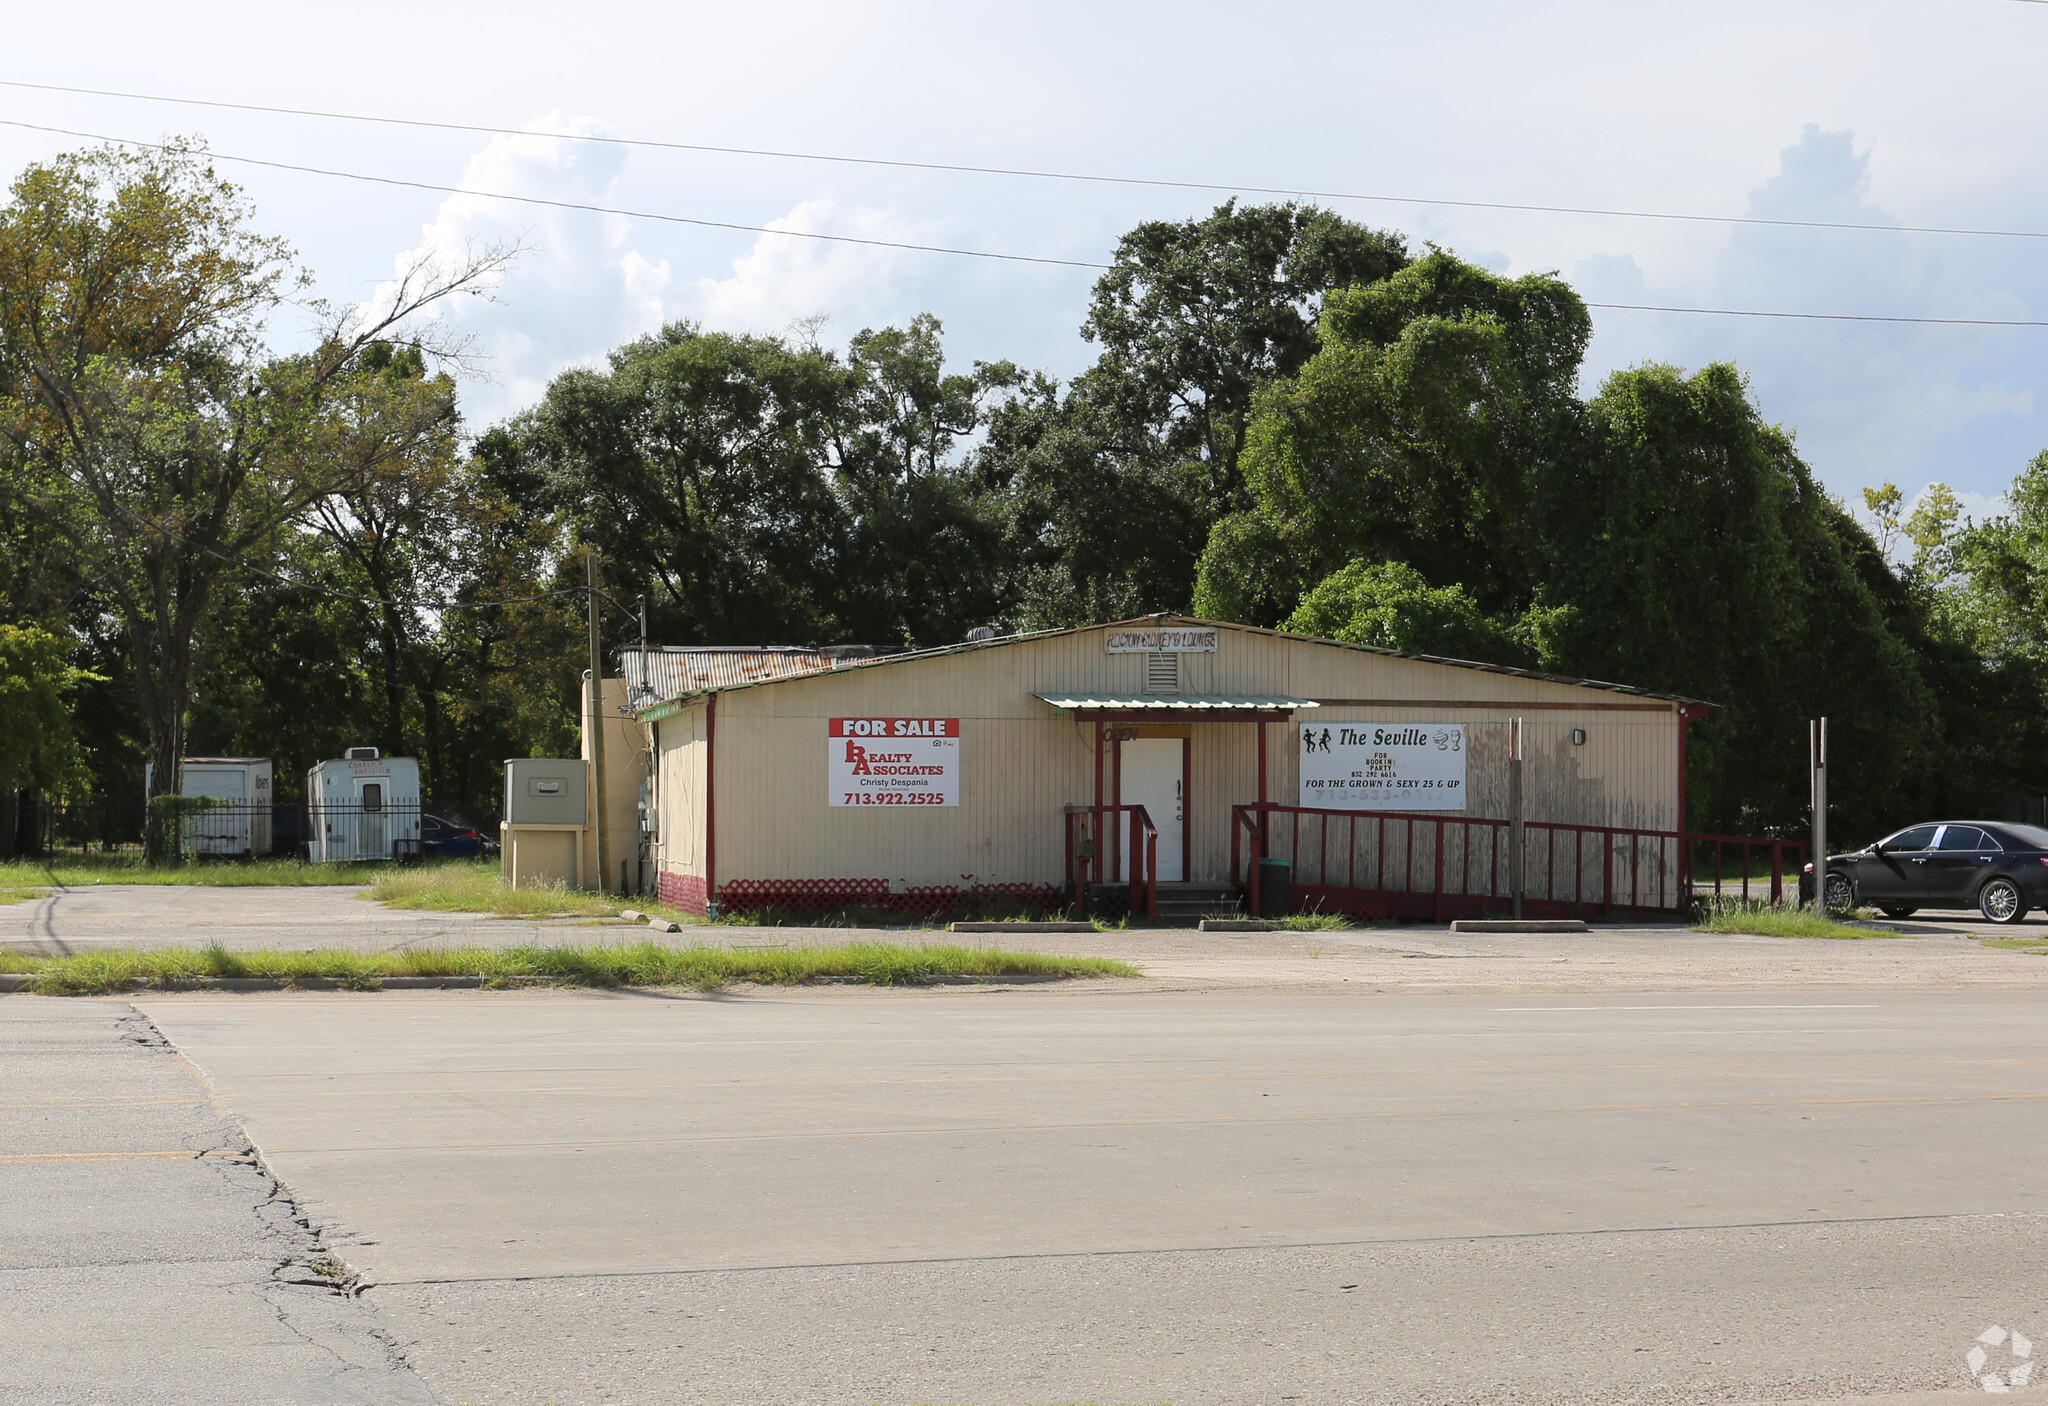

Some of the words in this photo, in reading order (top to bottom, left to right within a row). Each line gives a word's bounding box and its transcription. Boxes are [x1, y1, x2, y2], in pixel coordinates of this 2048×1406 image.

[1182, 632, 1216, 647] LOUNGE
[843, 719, 888, 736] FOR
[893, 719, 946, 736] SALE
[1103, 727, 1140, 742] OPEN
[1339, 728, 1367, 746] The
[1373, 728, 1427, 746] Seville
[845, 739, 913, 763] REALTY
[852, 756, 944, 776] ASSOCIATES
[860, 778, 889, 787] Christy
[891, 778, 928, 787] Despania
[1305, 779, 1325, 788] FOR
[1328, 779, 1346, 788] THE
[1349, 779, 1383, 788] GROWN
[1386, 779, 1393, 788] &
[1396, 779, 1420, 788] SEXY
[1423, 779, 1434, 788] 25
[1437, 779, 1444, 788] &
[1447, 779, 1460, 788] UP
[844, 793, 945, 804] 713.922.2525
